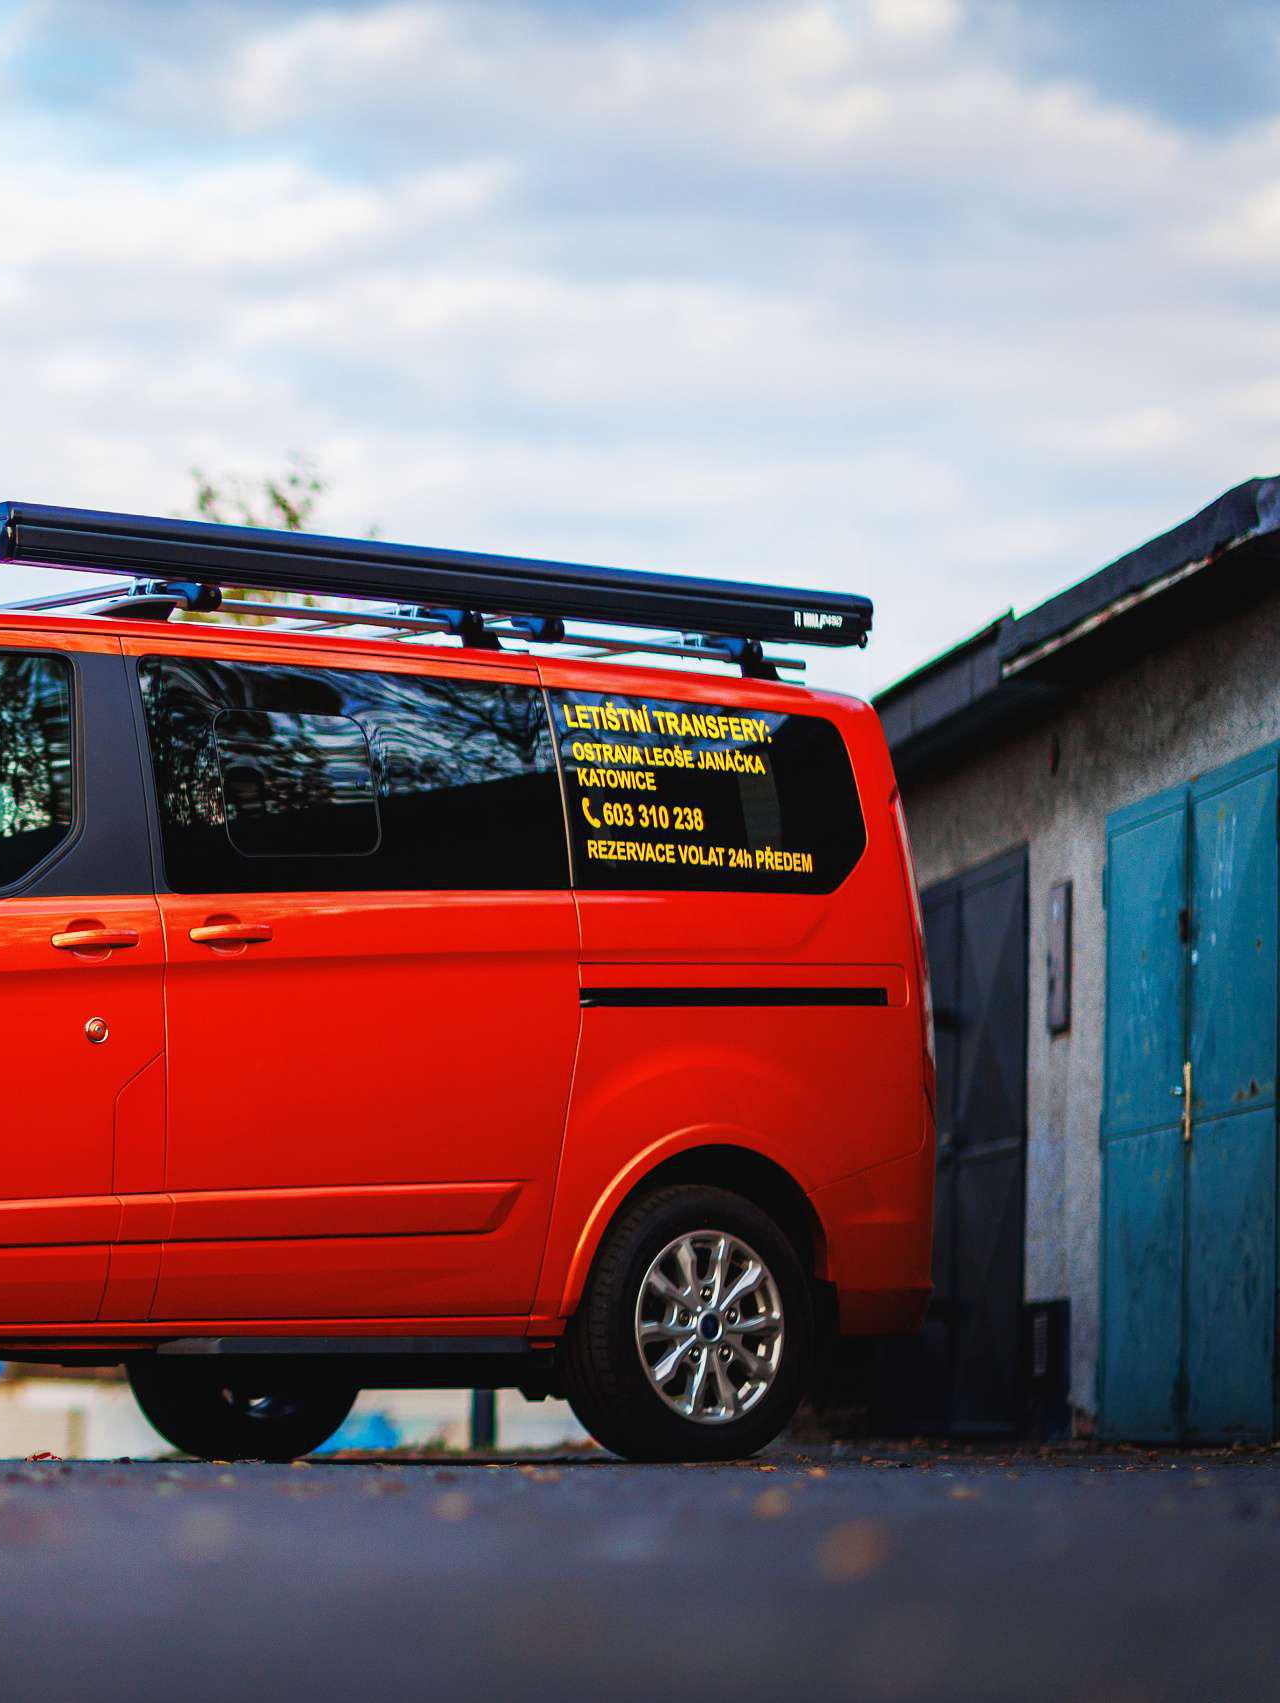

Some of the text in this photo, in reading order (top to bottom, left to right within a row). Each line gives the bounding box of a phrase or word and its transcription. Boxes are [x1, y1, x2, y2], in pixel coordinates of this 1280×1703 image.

[563, 702, 773, 744] LETIŠTNÍ TRANSFERY:
[571, 742, 766, 775] OSTRAVA LEOŠE JANÁČKA
[577, 768, 657, 791] KATOWICE
[602, 802, 705, 831] 603 310 238
[587, 839, 813, 873] REZERVACE VOLAT 24h PŘEDEM
